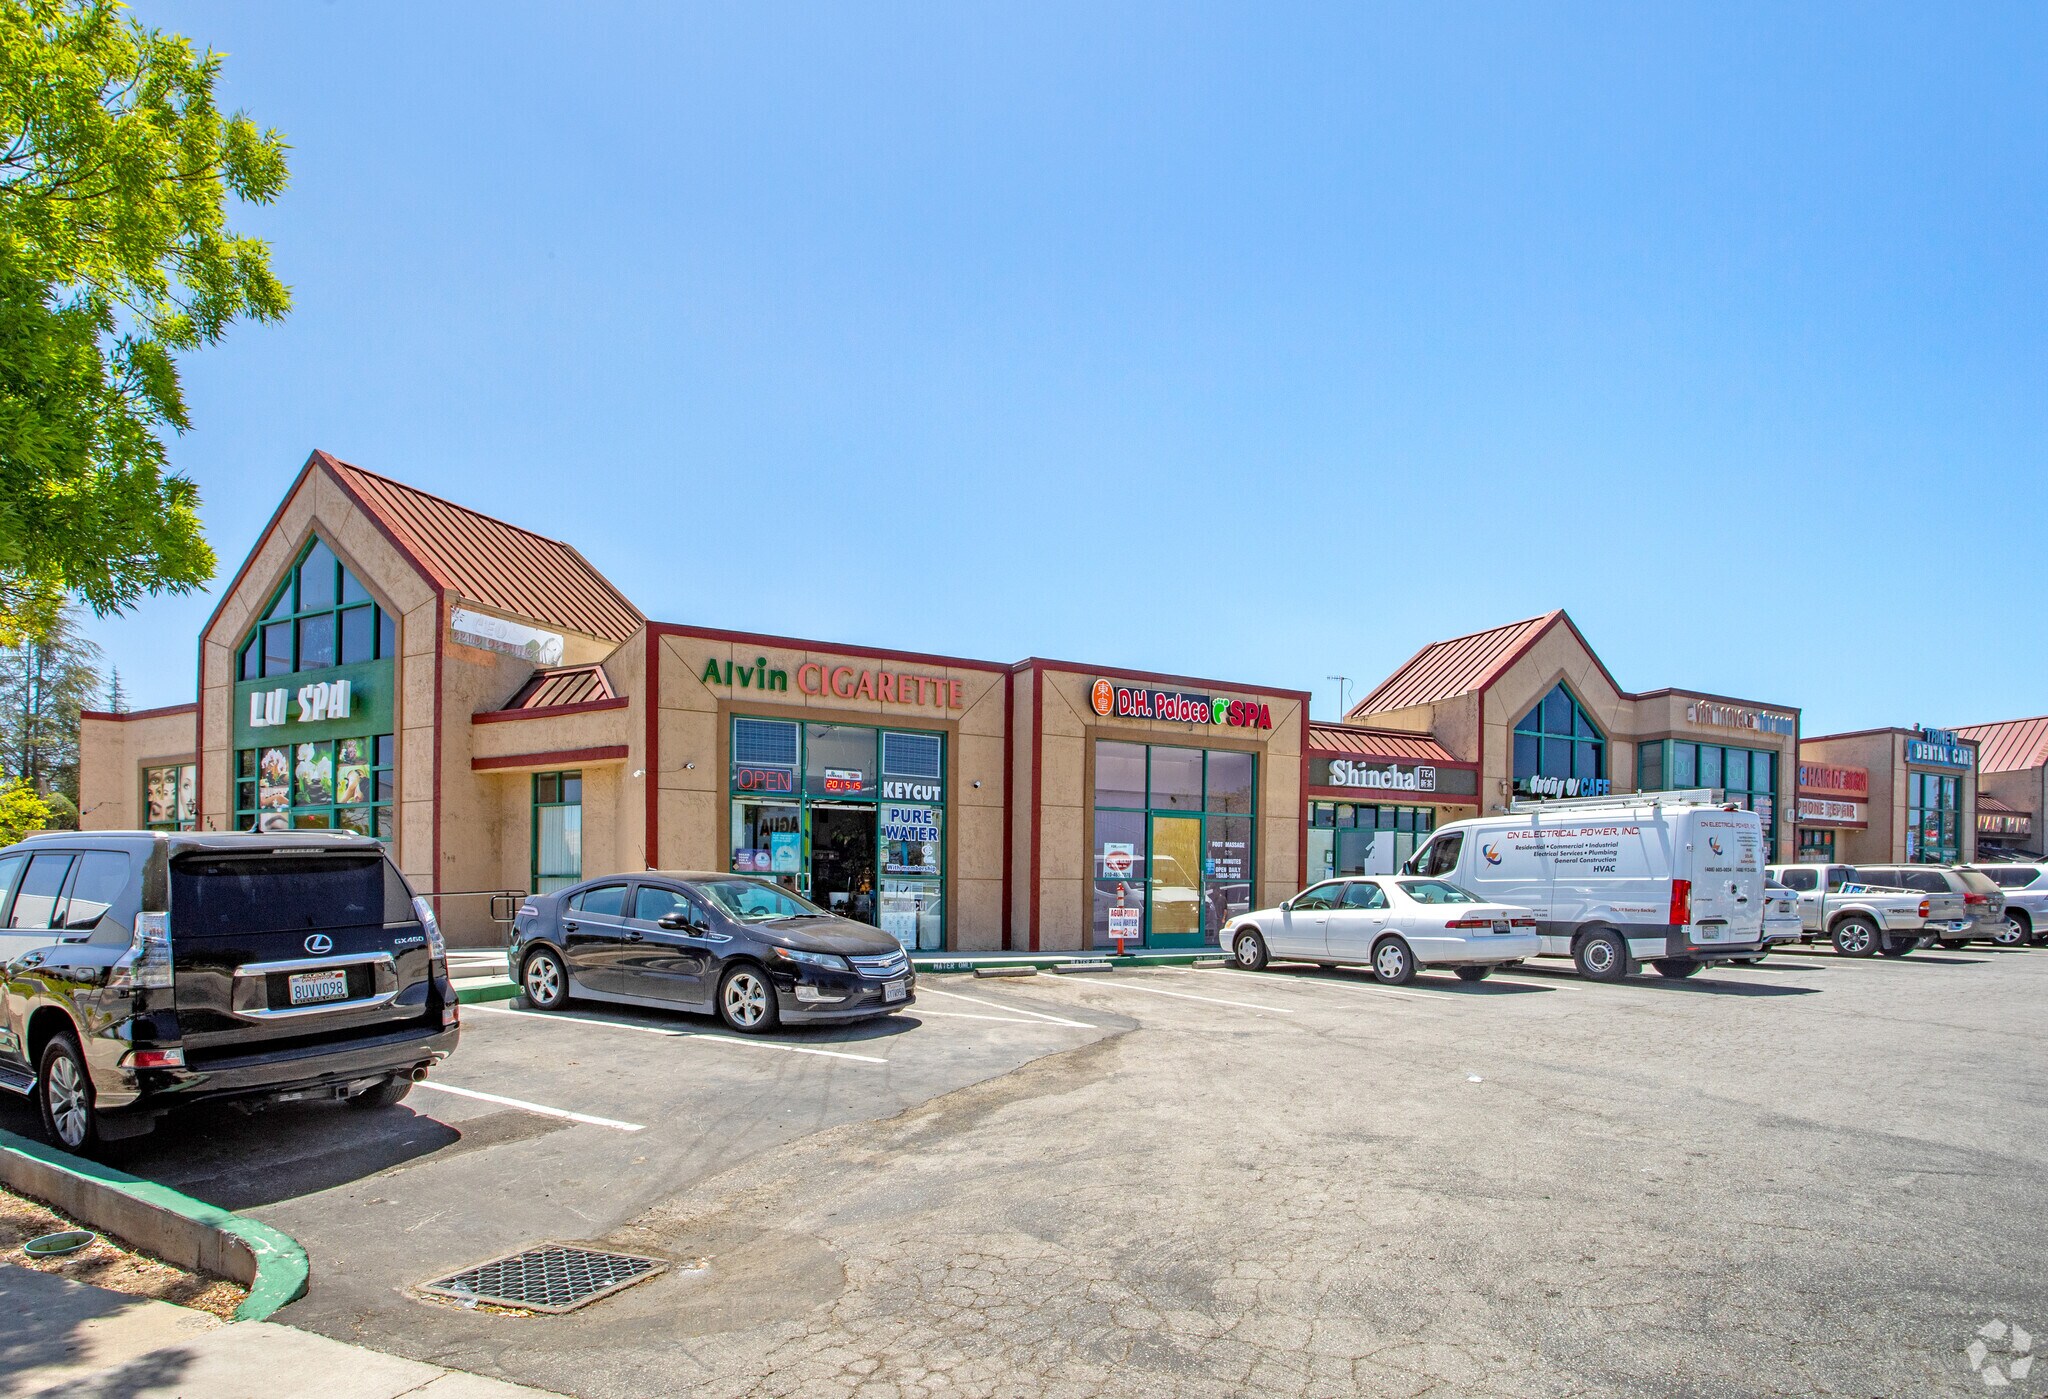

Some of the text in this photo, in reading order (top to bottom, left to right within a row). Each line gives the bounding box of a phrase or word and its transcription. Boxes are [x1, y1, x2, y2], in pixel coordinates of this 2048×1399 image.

[702, 656, 964, 709] Alvin CIGARETTE
[298, 680, 351, 722] SPA
[1118, 688, 1210, 724] D.H. Palace
[1229, 699, 1273, 730] SPA
[1916, 743, 1973, 766] DENTAL CARE
[739, 769, 791, 791] OPEN
[1329, 759, 1416, 790] Shincha
[1420, 769, 1433, 778] TEA
[883, 781, 941, 801] KEYCUT
[1580, 777, 1611, 797] CAFE
[891, 808, 932, 824] PURE
[1825, 801, 1855, 818] REPAIR
[885, 825, 939, 842] WATER
[1507, 826, 1641, 839] CN ELECTRICAL POWER, INC.
[901, 864, 937, 873] membership
[1593, 865, 1616, 873] HVAC
[1110, 909, 1123, 917] AGUA
